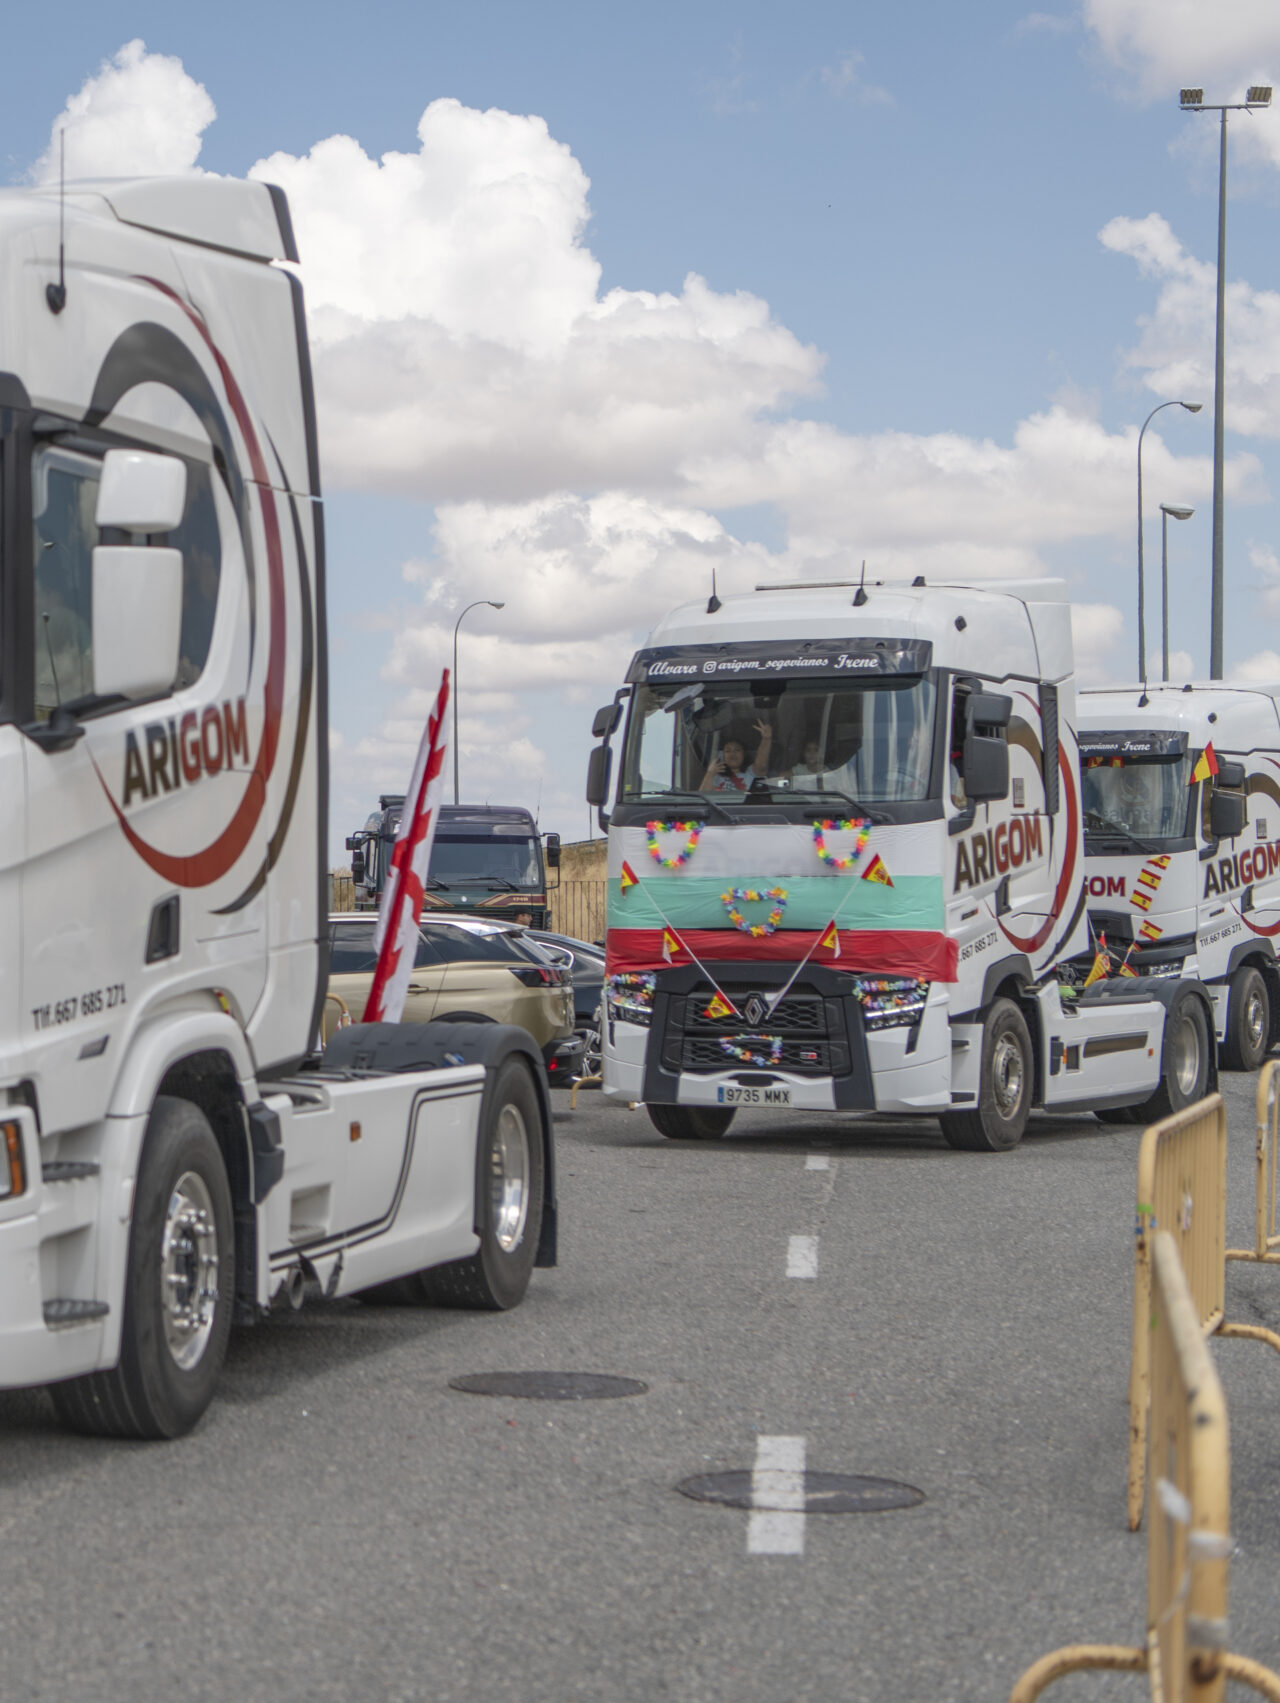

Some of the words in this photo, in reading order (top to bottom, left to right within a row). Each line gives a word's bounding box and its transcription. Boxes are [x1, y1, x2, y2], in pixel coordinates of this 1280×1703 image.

[648, 662, 698, 676] Alvaro
[718, 656, 829, 672] arigom_segovianos
[834, 654, 879, 668] Irene
[123, 695, 250, 808] ARIGOM
[1121, 740, 1151, 751] Irene
[953, 809, 1043, 895] ARIGOM
[1231, 922, 1242, 933] 271
[986, 930, 998, 947] 271
[31, 997, 78, 1031] Tlf.667
[81, 990, 103, 1016] 685
[106, 982, 126, 1008] 271
[726, 1088, 760, 1102] 9735
[764, 1089, 790, 1103] MMX
